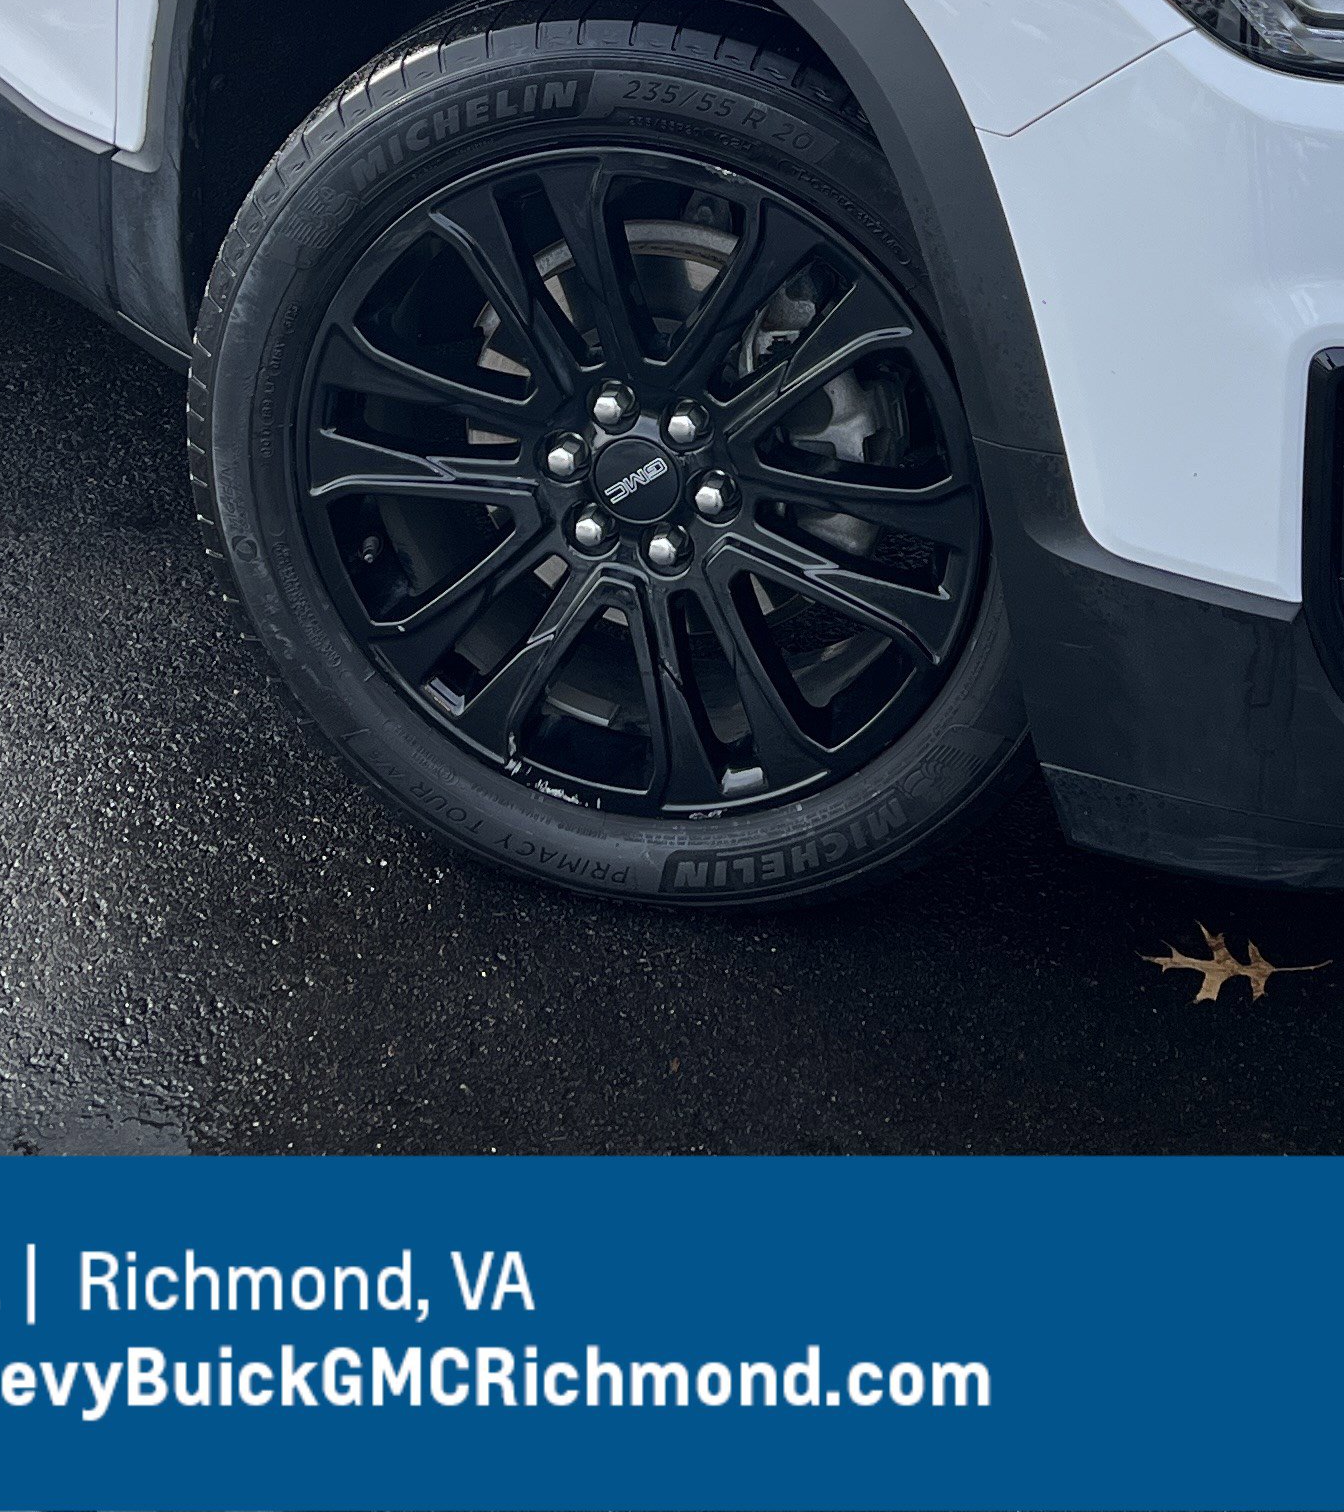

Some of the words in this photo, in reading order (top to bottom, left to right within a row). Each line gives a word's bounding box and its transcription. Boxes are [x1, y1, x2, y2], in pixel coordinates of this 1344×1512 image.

[351, 80, 578, 187] MICHELIN
[622, 79, 736, 117] 235/55
[741, 107, 767, 129] R
[771, 122, 814, 150] 20
[604, 457, 668, 504] GMC
[411, 781, 485, 834] TOUR
[503, 834, 630, 885] PRIMACY
[673, 797, 907, 888] MICHELIN
